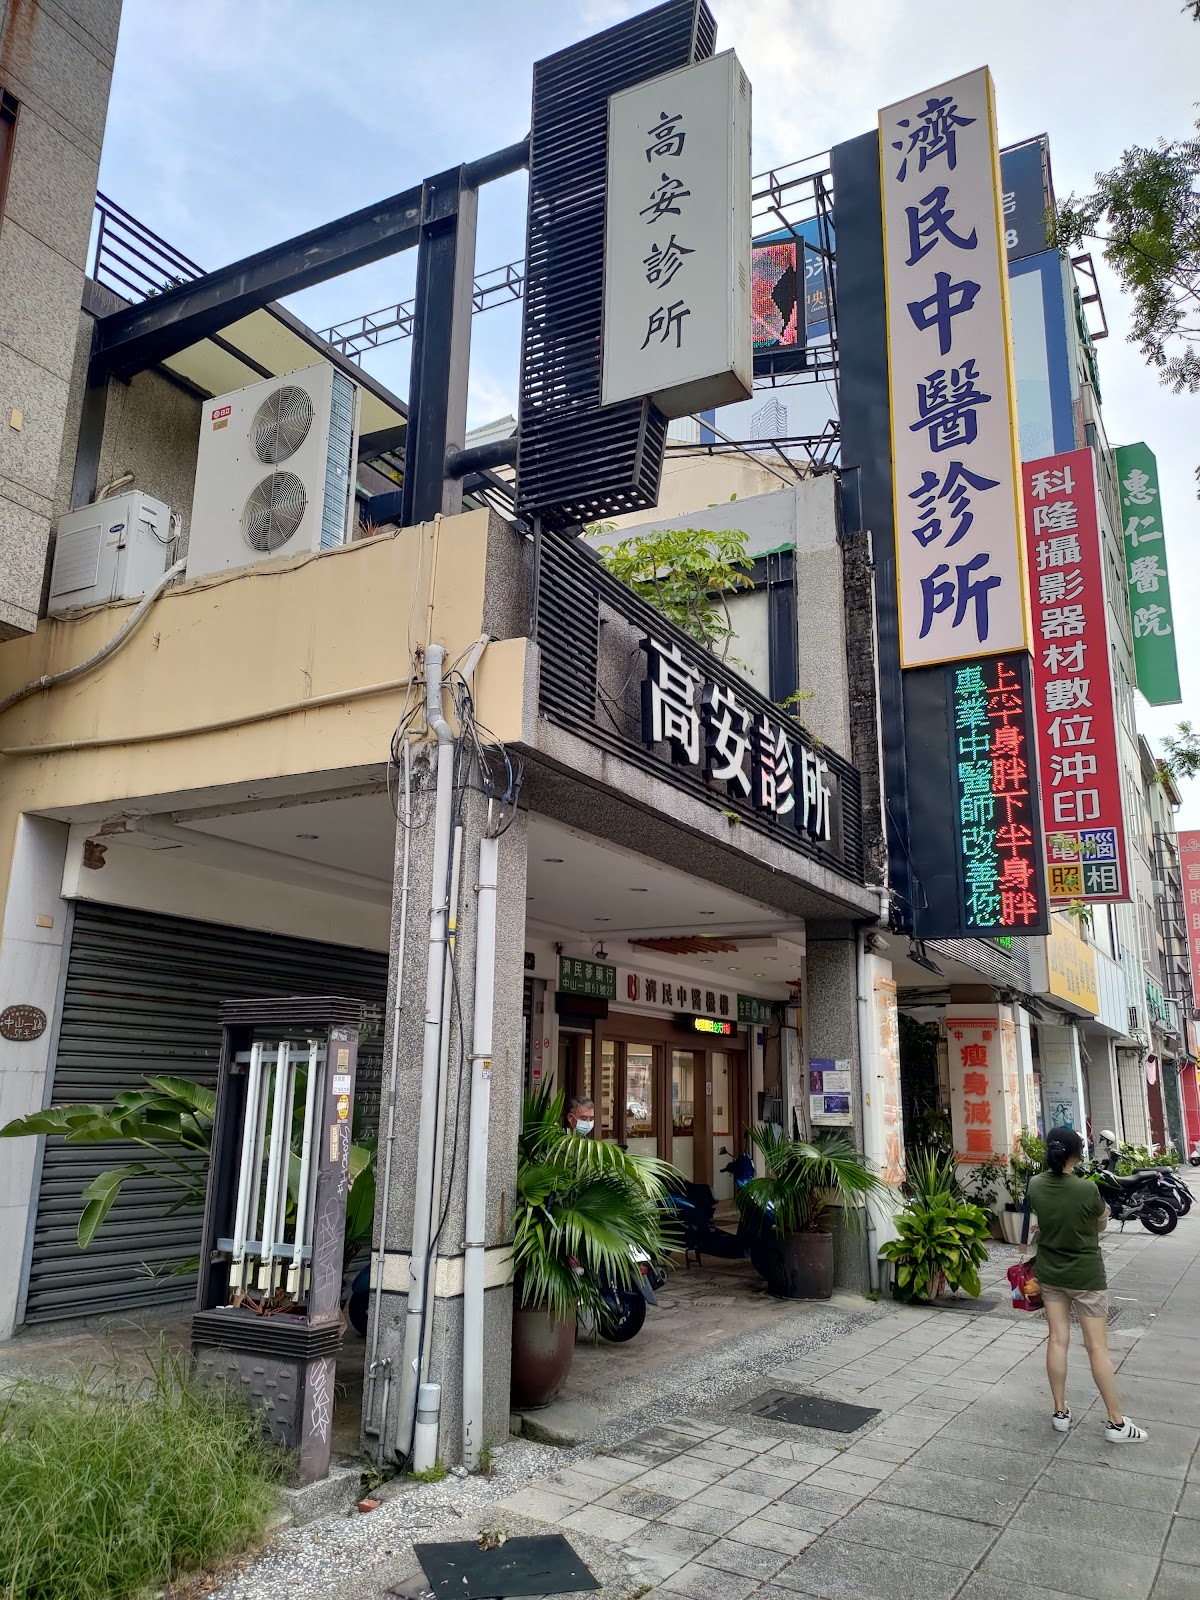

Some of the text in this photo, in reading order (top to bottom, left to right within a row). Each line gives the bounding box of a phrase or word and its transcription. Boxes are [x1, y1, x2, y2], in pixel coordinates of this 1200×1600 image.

[639, 111, 696, 351] 高安診所
[891, 96, 1002, 643] 濟民中醫診所
[1031, 465, 1101, 824] 科隆攝影器材數位沖印
[1123, 468, 1172, 639] 惠仁醫院
[649, 636, 831, 841] 高安診所
[954, 665, 1002, 927] 專業中醫師改善您
[986, 661, 1038, 926] 上半身胖下半身胖
[1051, 865, 1118, 893] 照相
[960, 1043, 993, 1153] 瘦身減重
